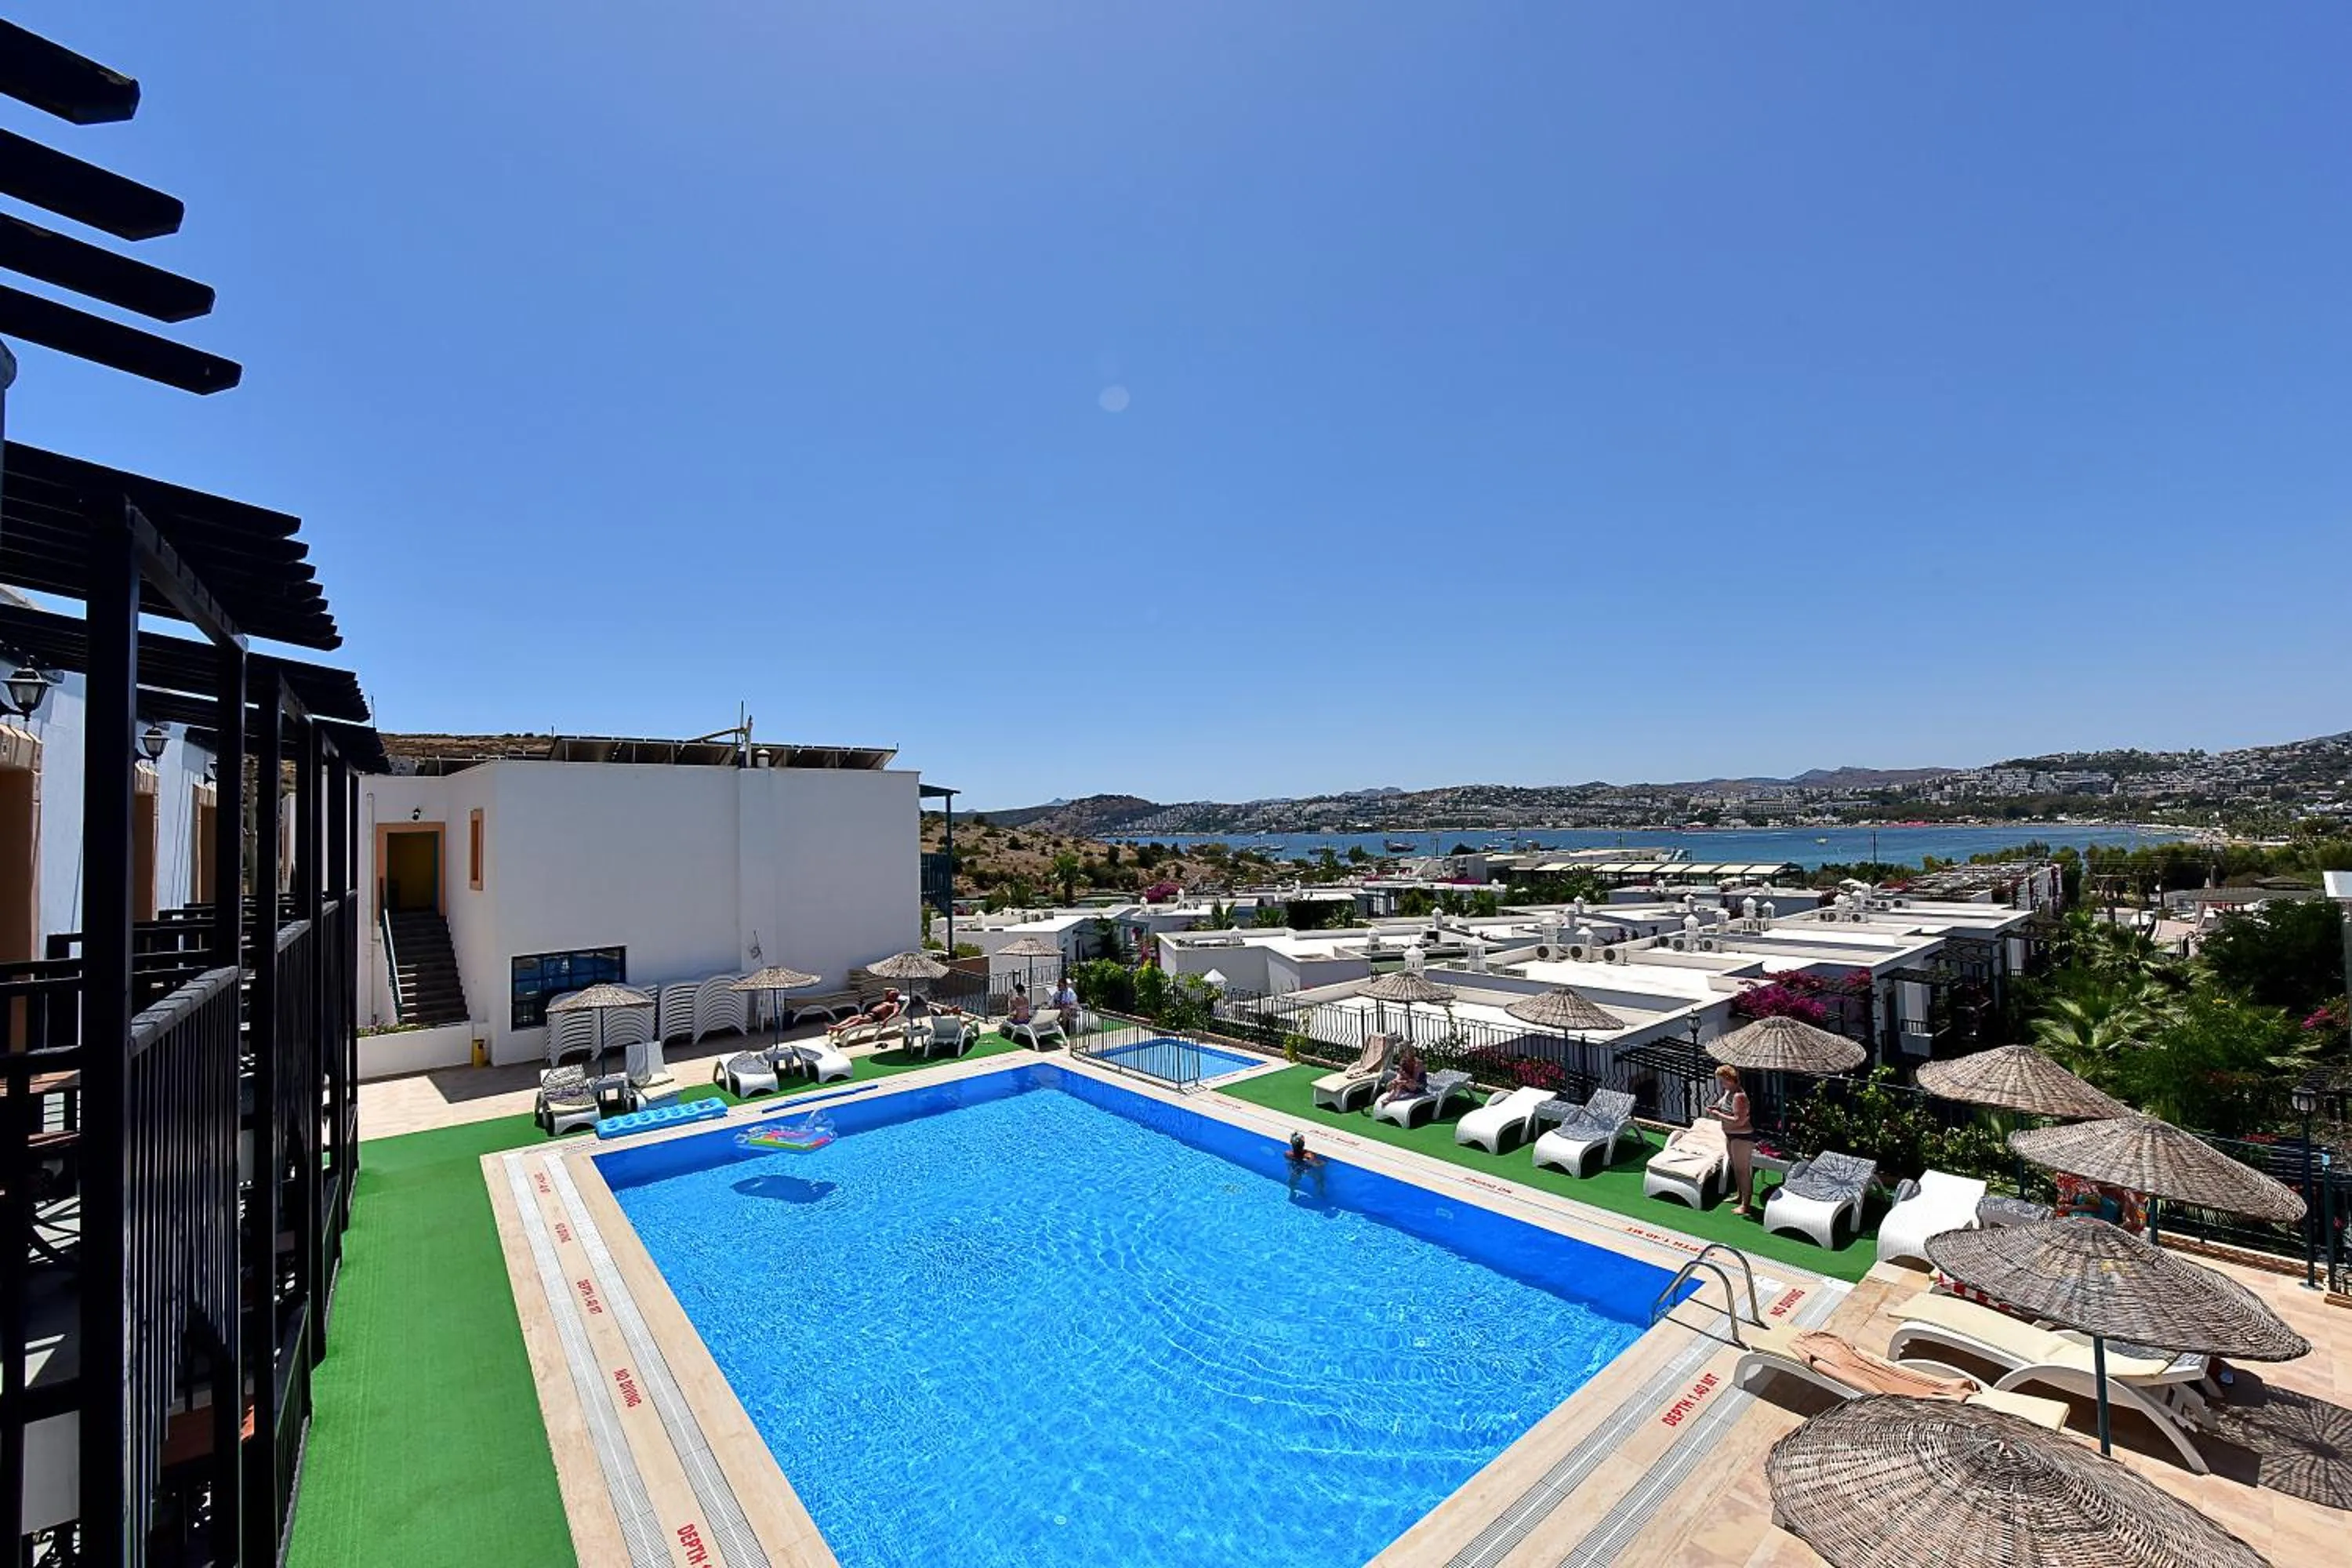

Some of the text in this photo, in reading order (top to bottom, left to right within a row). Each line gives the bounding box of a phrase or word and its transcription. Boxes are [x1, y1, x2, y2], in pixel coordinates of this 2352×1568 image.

[1673, 1241, 1715, 1257] DPTH
[1769, 1288, 1806, 1317] NO DIVING
[1661, 1373, 1719, 1427] DEPTH 1.40 MT
[677, 1523, 708, 1566] DEPTH
